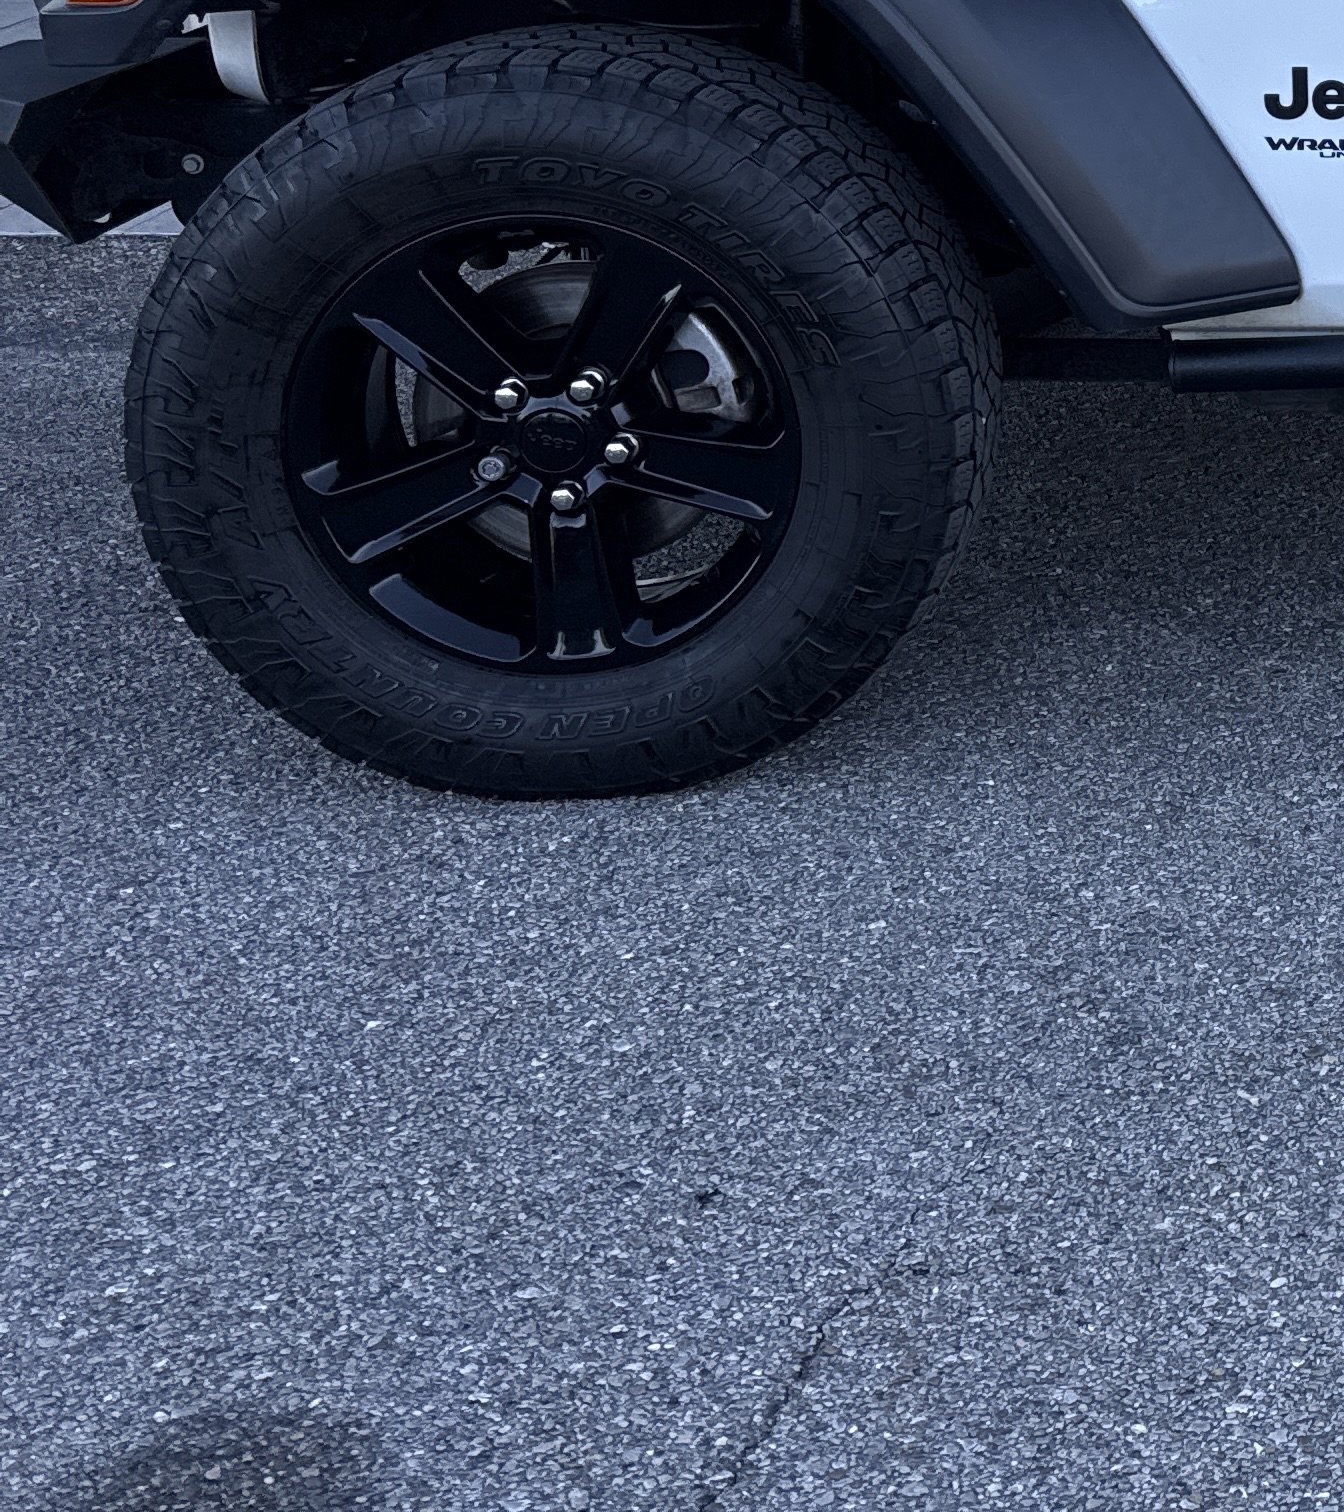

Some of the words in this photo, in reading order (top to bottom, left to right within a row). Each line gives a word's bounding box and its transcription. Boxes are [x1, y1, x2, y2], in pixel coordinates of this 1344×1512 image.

[472, 156, 671, 208] TOYO
[676, 201, 842, 368] TIRES
[246, 574, 527, 740] COUNTRY
[536, 675, 717, 741] OPEN
